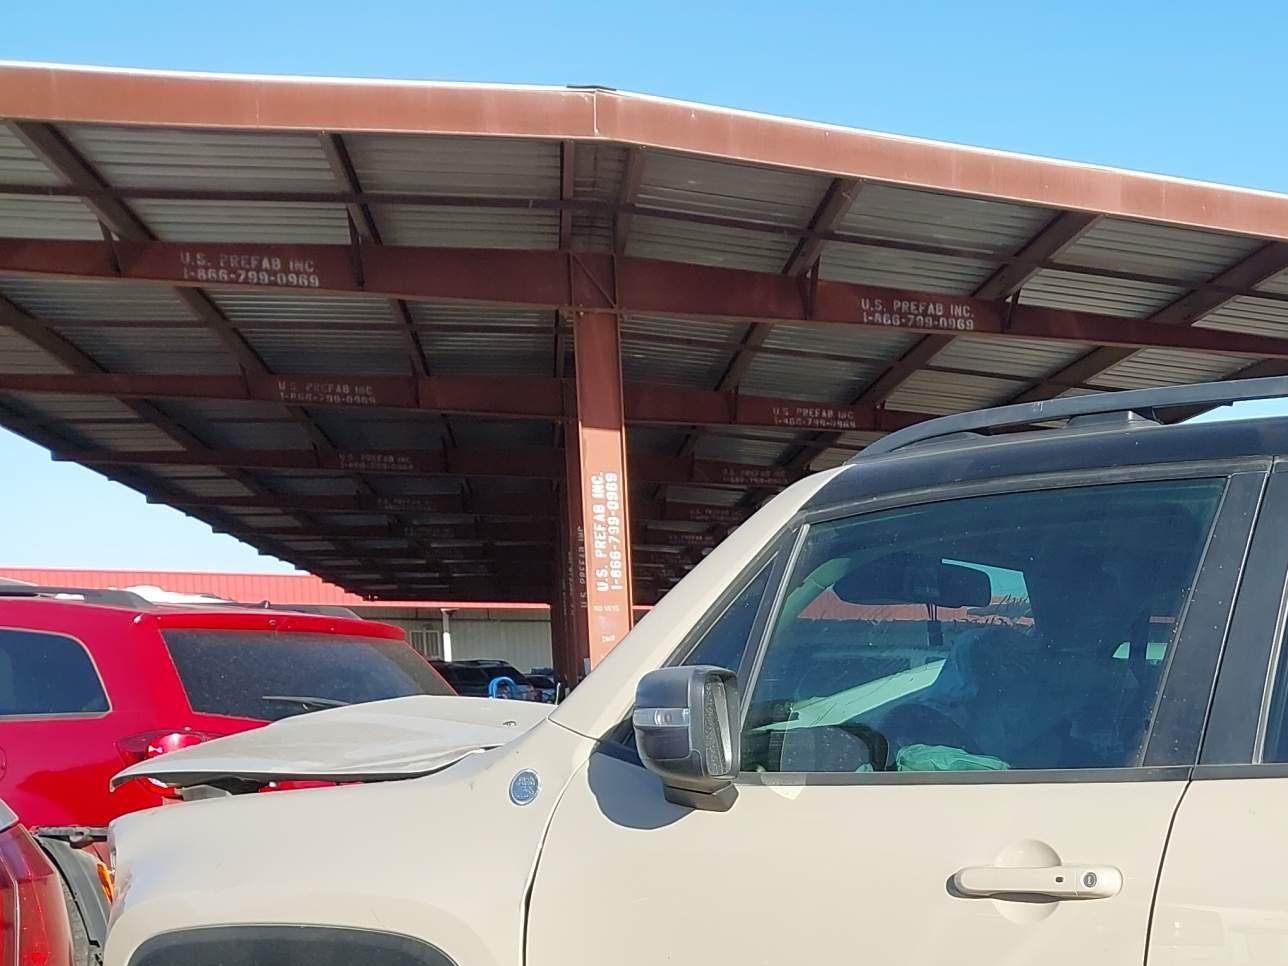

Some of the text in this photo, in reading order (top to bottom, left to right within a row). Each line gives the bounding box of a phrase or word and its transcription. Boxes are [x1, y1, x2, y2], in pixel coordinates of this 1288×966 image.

[219, 254, 282, 271] PREFAB
[893, 300, 943, 316] PREFAB
[591, 471, 606, 499] INC.
[592, 504, 608, 559] PREFAB
[605, 472, 625, 590] 1-866-799-0969
[596, 565, 609, 592] U.S.
